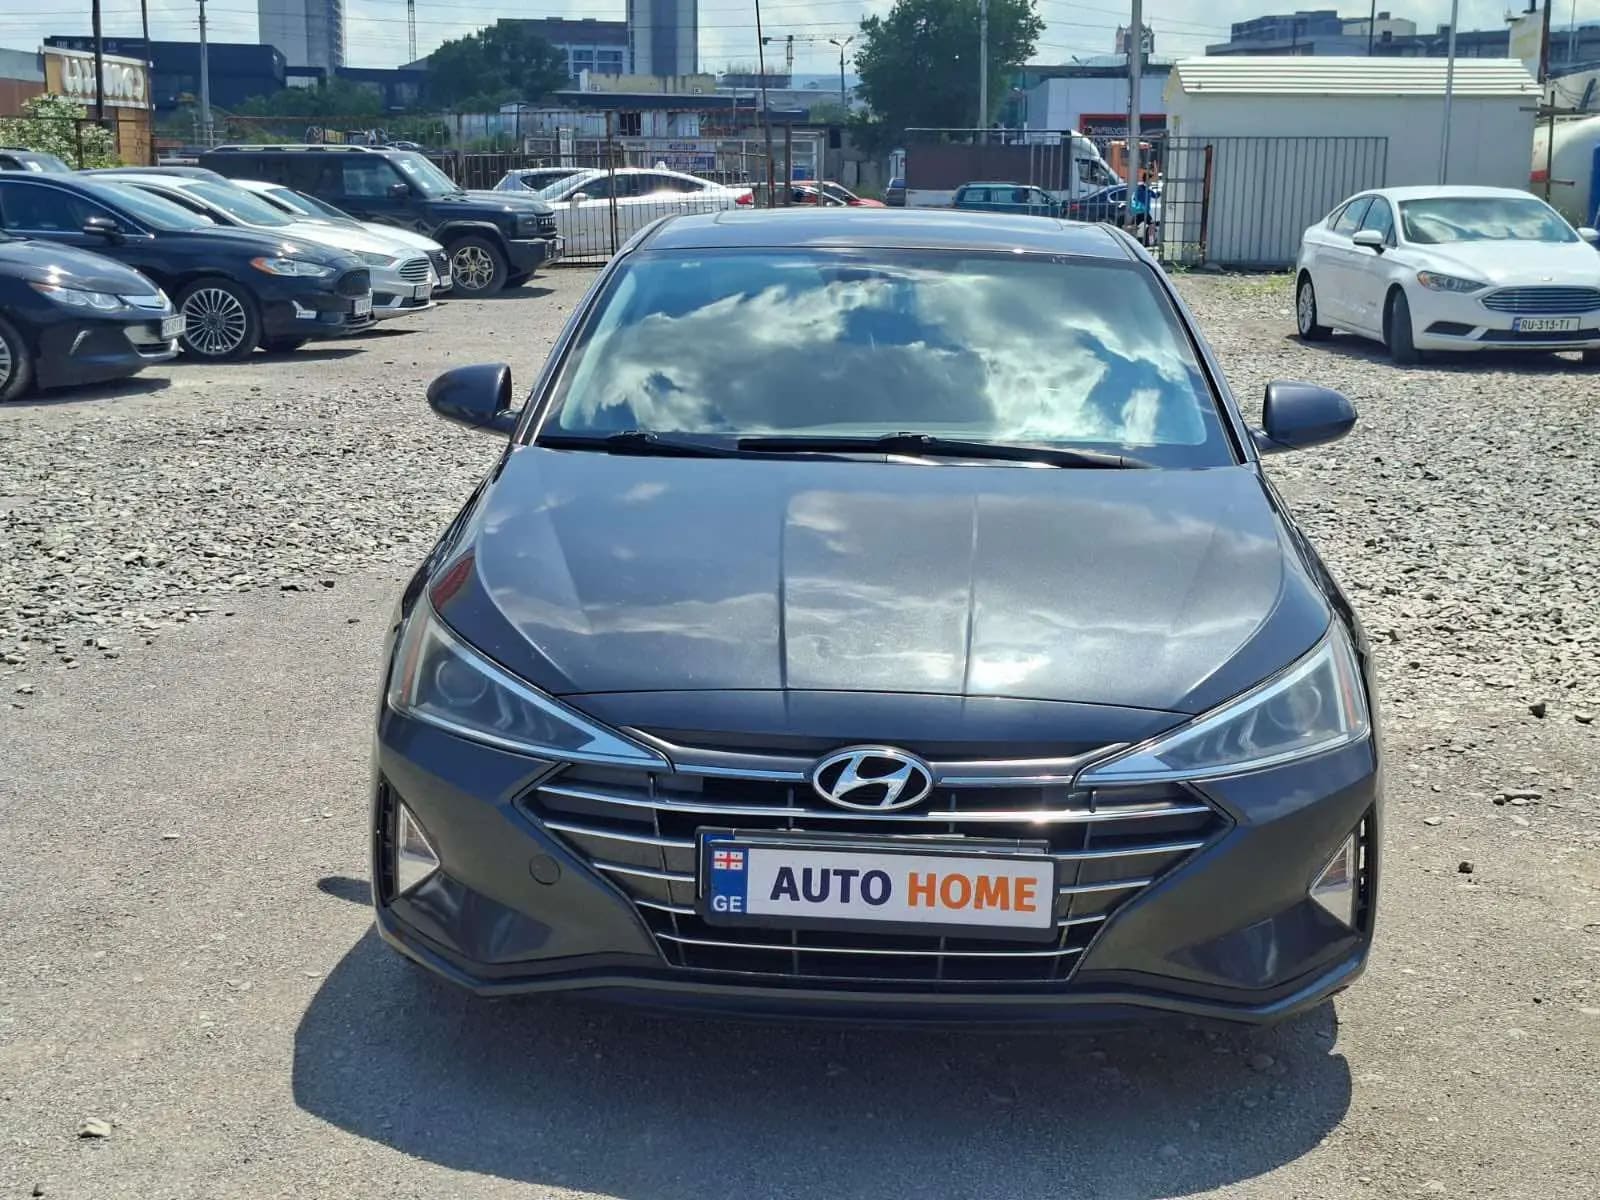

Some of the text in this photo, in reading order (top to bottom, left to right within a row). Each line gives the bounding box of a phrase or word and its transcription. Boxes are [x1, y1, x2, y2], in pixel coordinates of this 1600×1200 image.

[713, 895, 742, 913] GE
[769, 866, 1038, 913] AUTO HOME
